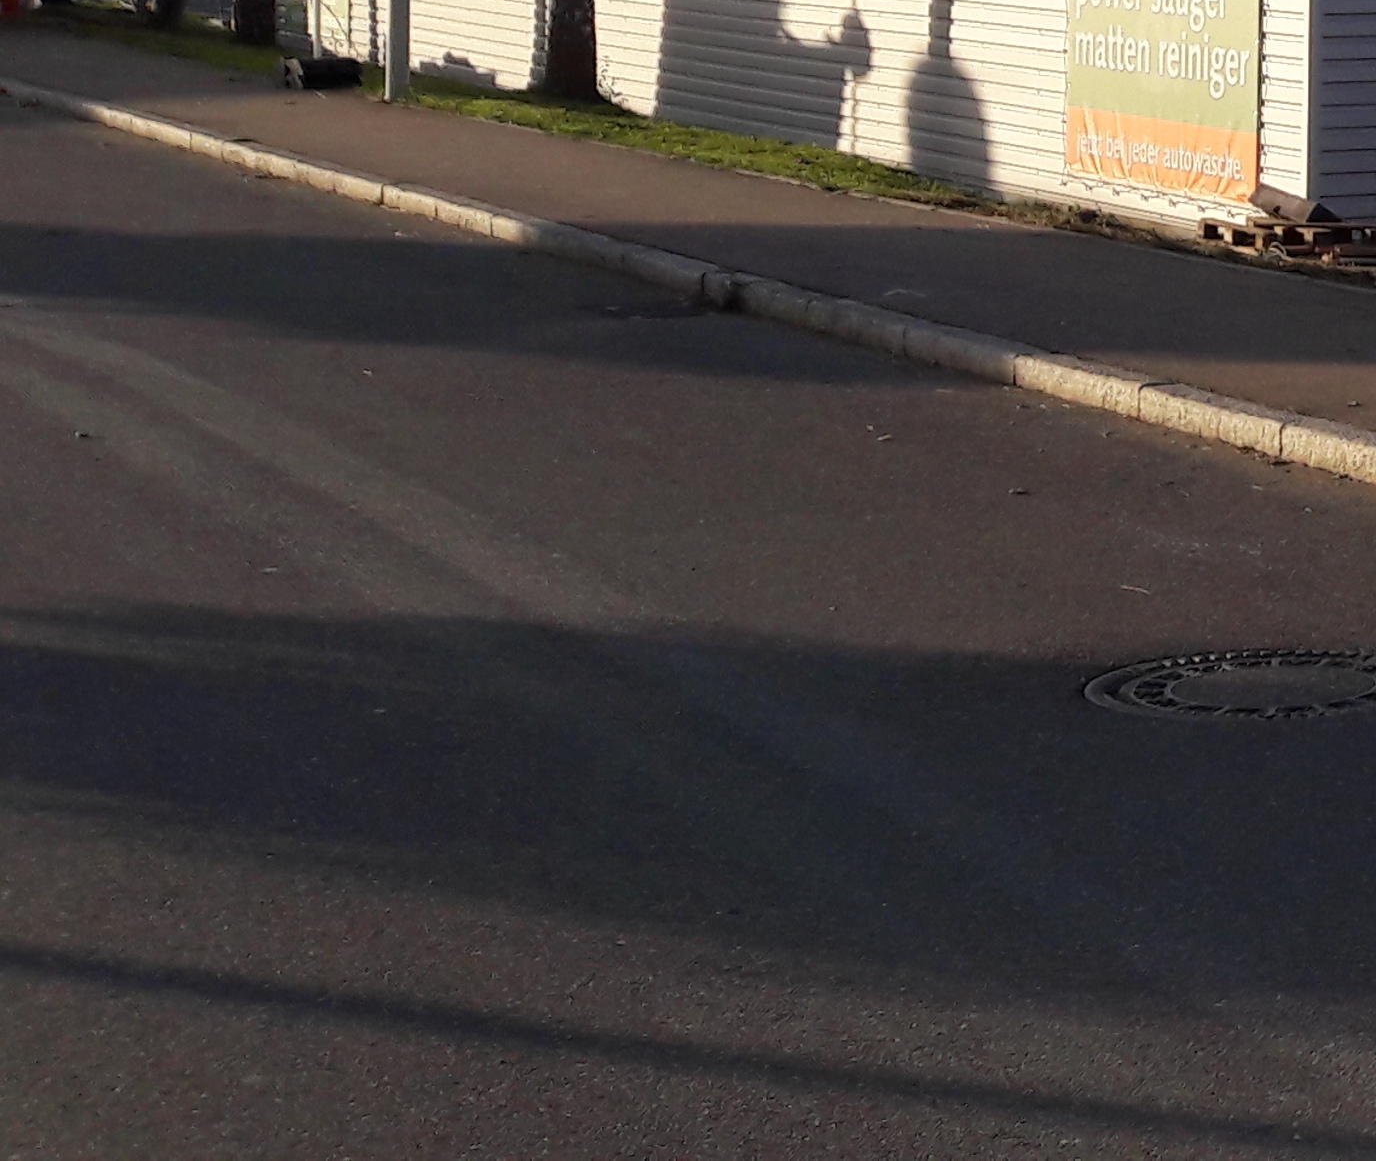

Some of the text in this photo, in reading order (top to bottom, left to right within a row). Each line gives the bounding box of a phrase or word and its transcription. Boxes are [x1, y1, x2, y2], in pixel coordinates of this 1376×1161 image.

[1074, 24, 1250, 100] matten reiniger
[1127, 135, 1160, 168] jeder
